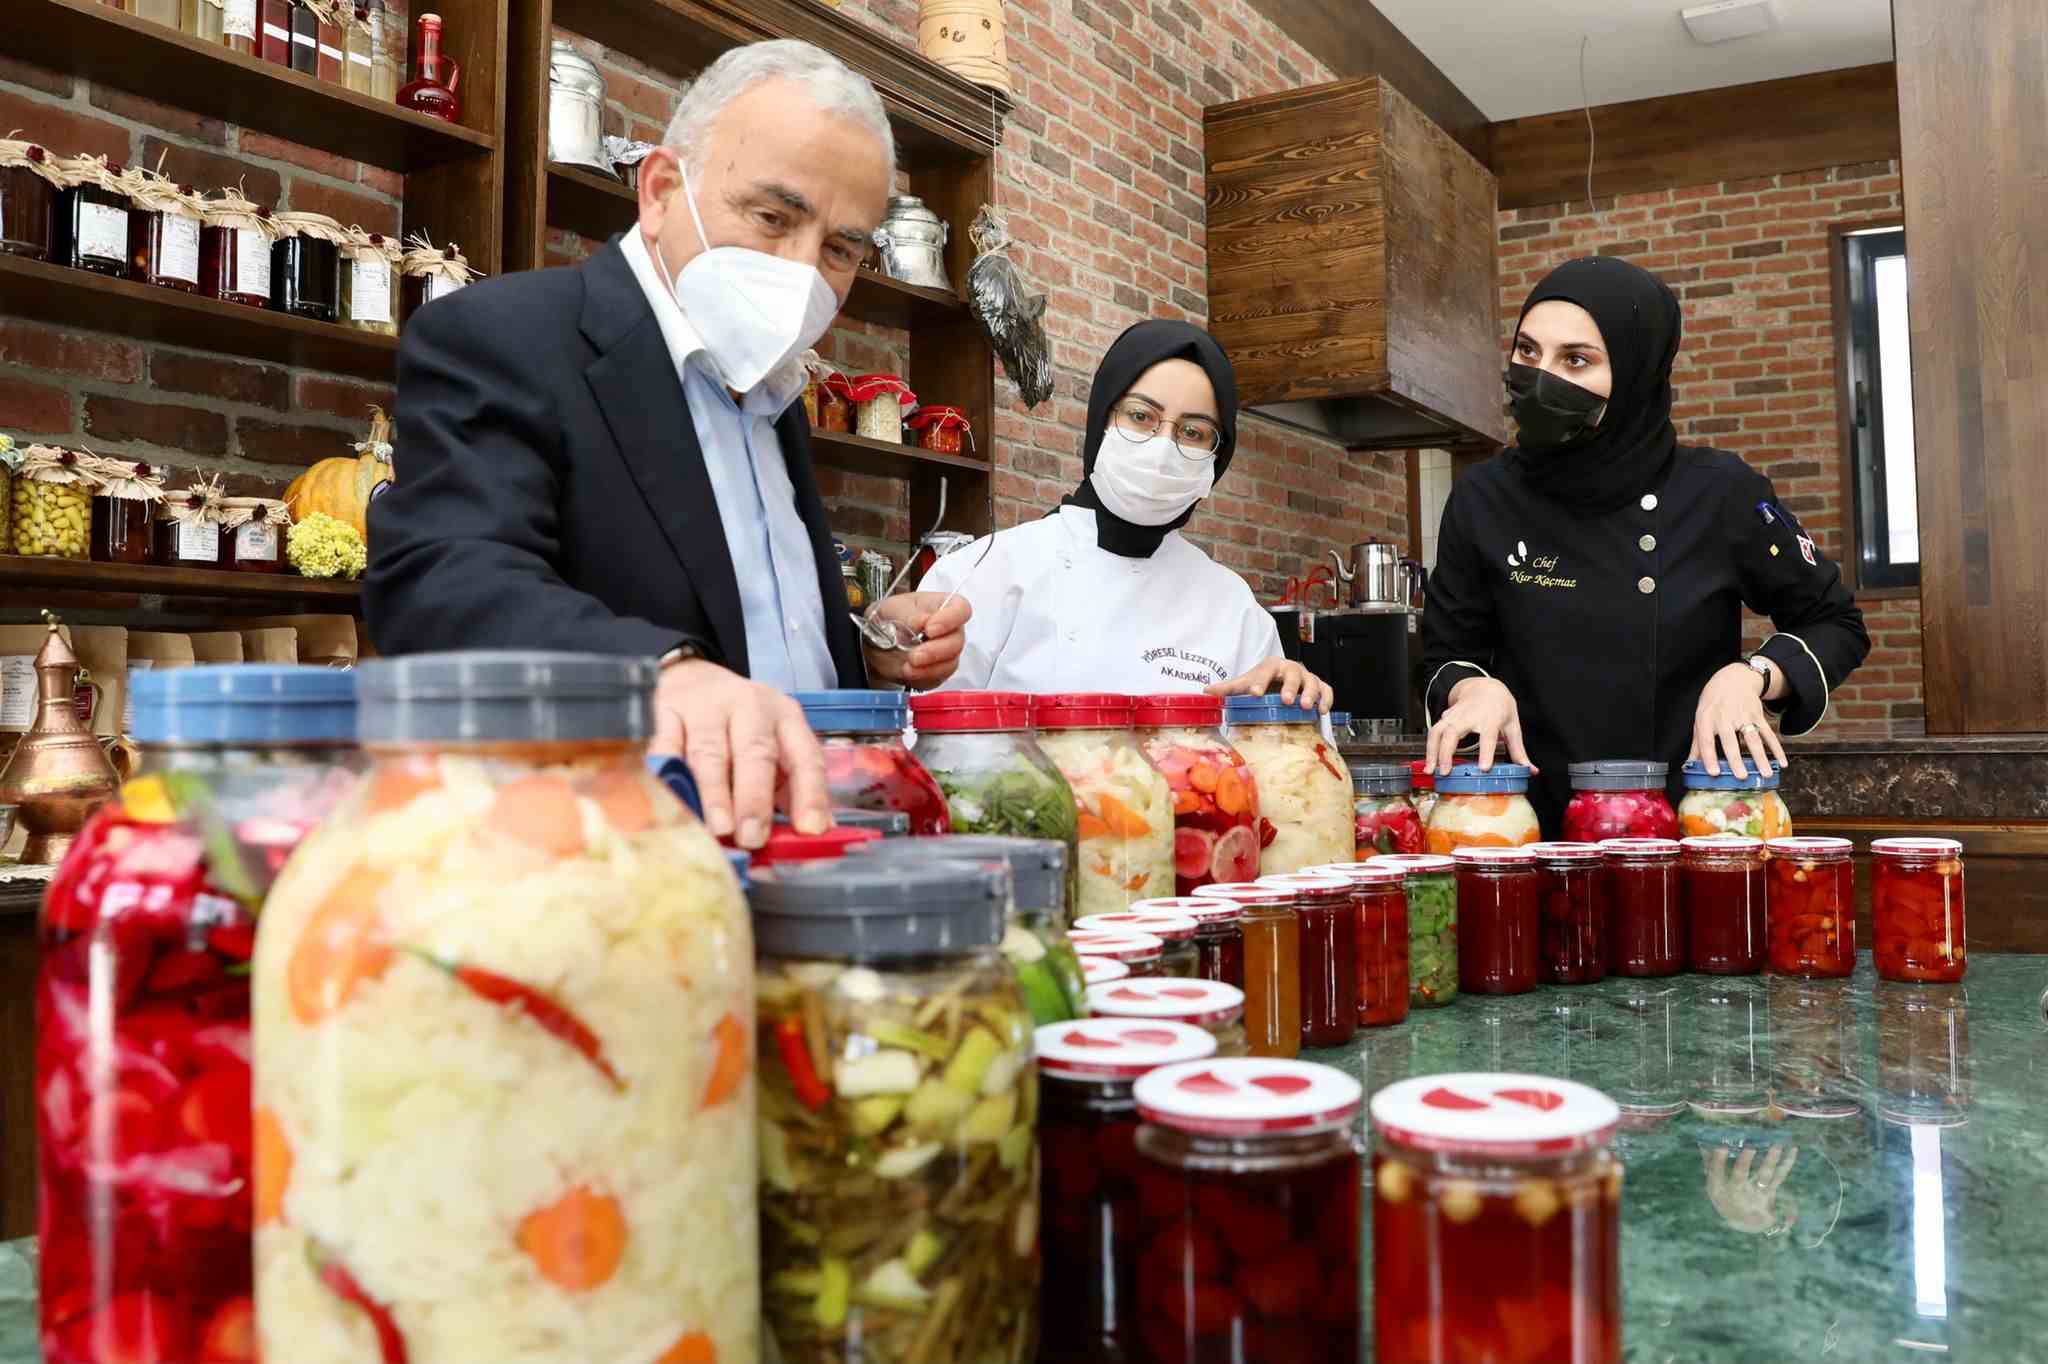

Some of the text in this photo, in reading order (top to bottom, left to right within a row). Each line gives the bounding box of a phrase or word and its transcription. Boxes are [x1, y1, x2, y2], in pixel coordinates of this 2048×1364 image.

[1532, 557, 1559, 572] Chef
[1510, 571, 1533, 584] Nur
[1141, 647, 1228, 680] YÖRESEL LEZZETLER
[1161, 666, 1211, 684] AKADEMİSİ
